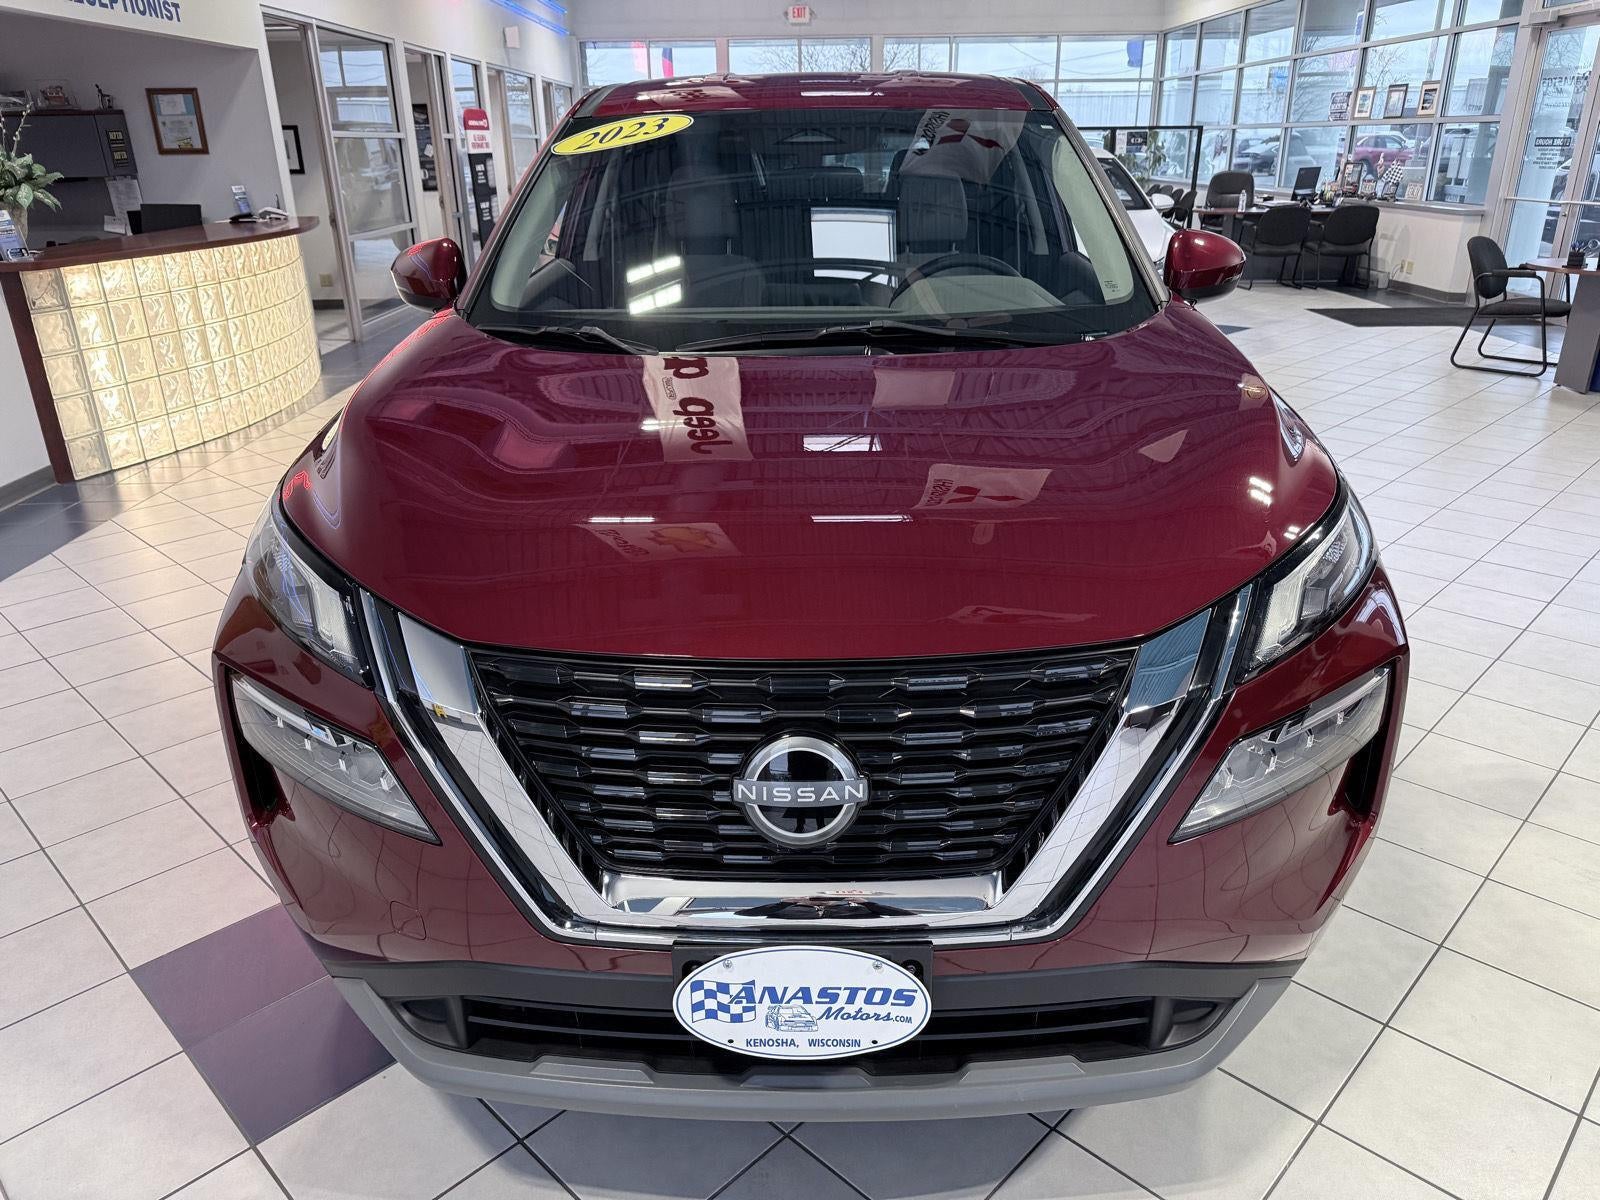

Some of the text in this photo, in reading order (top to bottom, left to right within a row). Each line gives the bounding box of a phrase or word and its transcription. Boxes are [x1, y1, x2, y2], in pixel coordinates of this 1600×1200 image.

[792, 6, 806, 19] EXIT
[573, 117, 670, 151] 2023
[737, 783, 864, 802] NISSAN
[729, 985, 919, 1008] ANASTOS
[745, 1037, 861, 1049] KENOSHA, WISCONSIN
